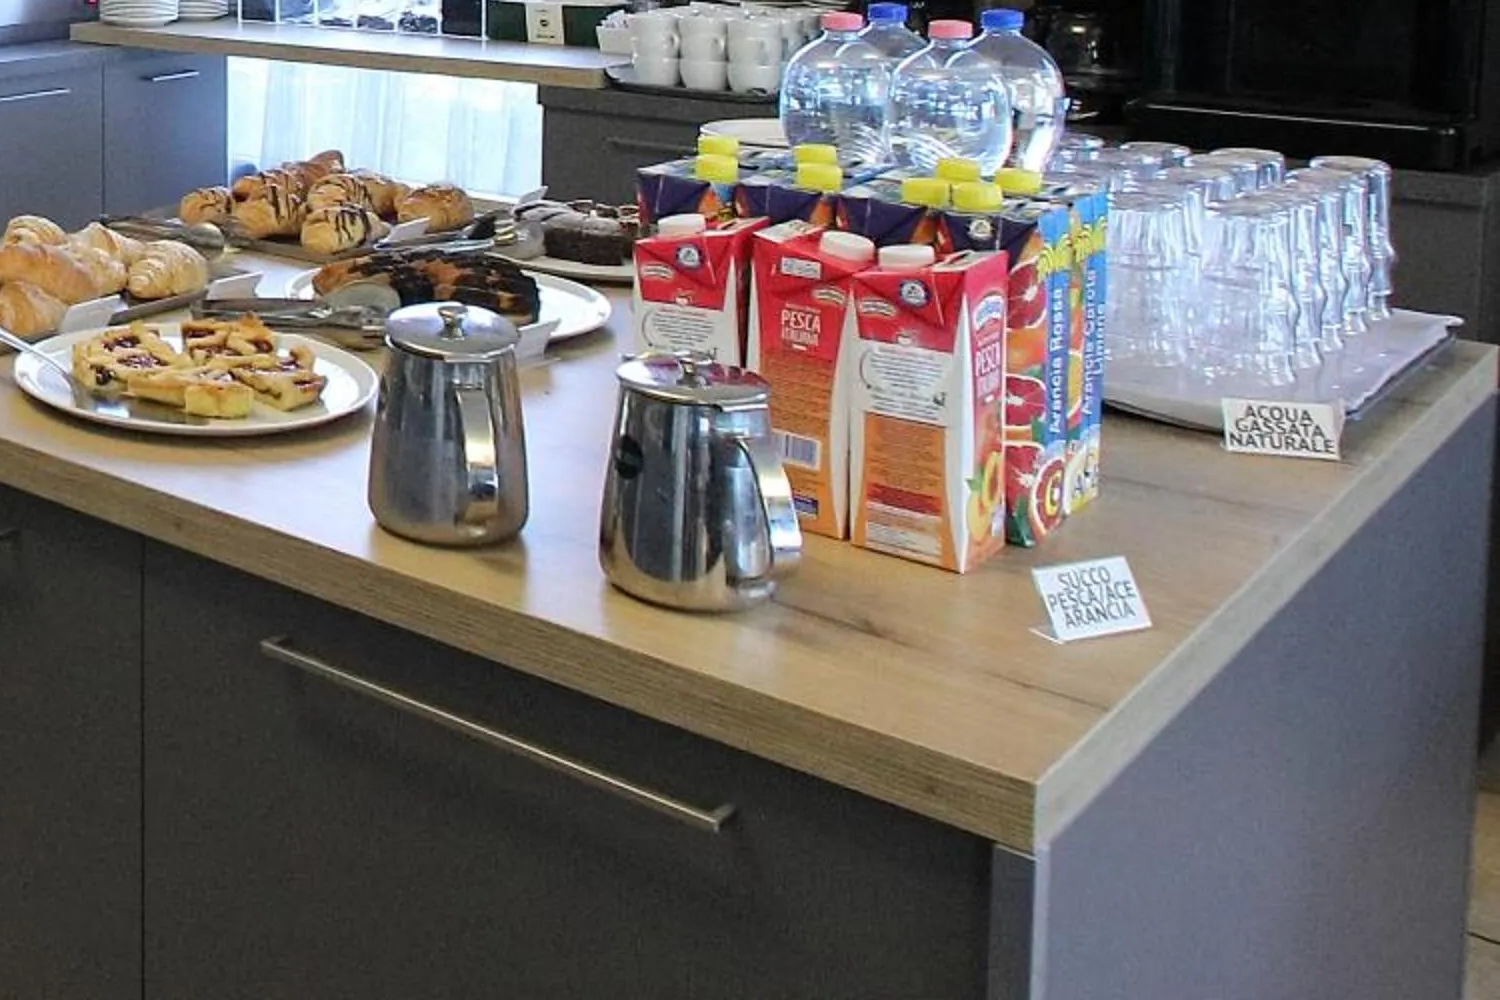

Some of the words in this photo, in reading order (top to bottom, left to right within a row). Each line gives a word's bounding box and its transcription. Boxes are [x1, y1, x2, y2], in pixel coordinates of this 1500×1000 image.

[780, 309, 821, 333] PESCA
[1050, 287, 1064, 351] Rossa
[1080, 342, 1096, 415] Arancia
[1048, 356, 1064, 434] Arancia
[1244, 402, 1314, 424] ACQUA
[1235, 417, 1327, 439] GASSATA
[1228, 431, 1336, 455] NATURALE
[1058, 565, 1111, 590] SUCCO
[1047, 580, 1137, 613] PESCA/ACE
[1064, 600, 1137, 629] ARANCIA
